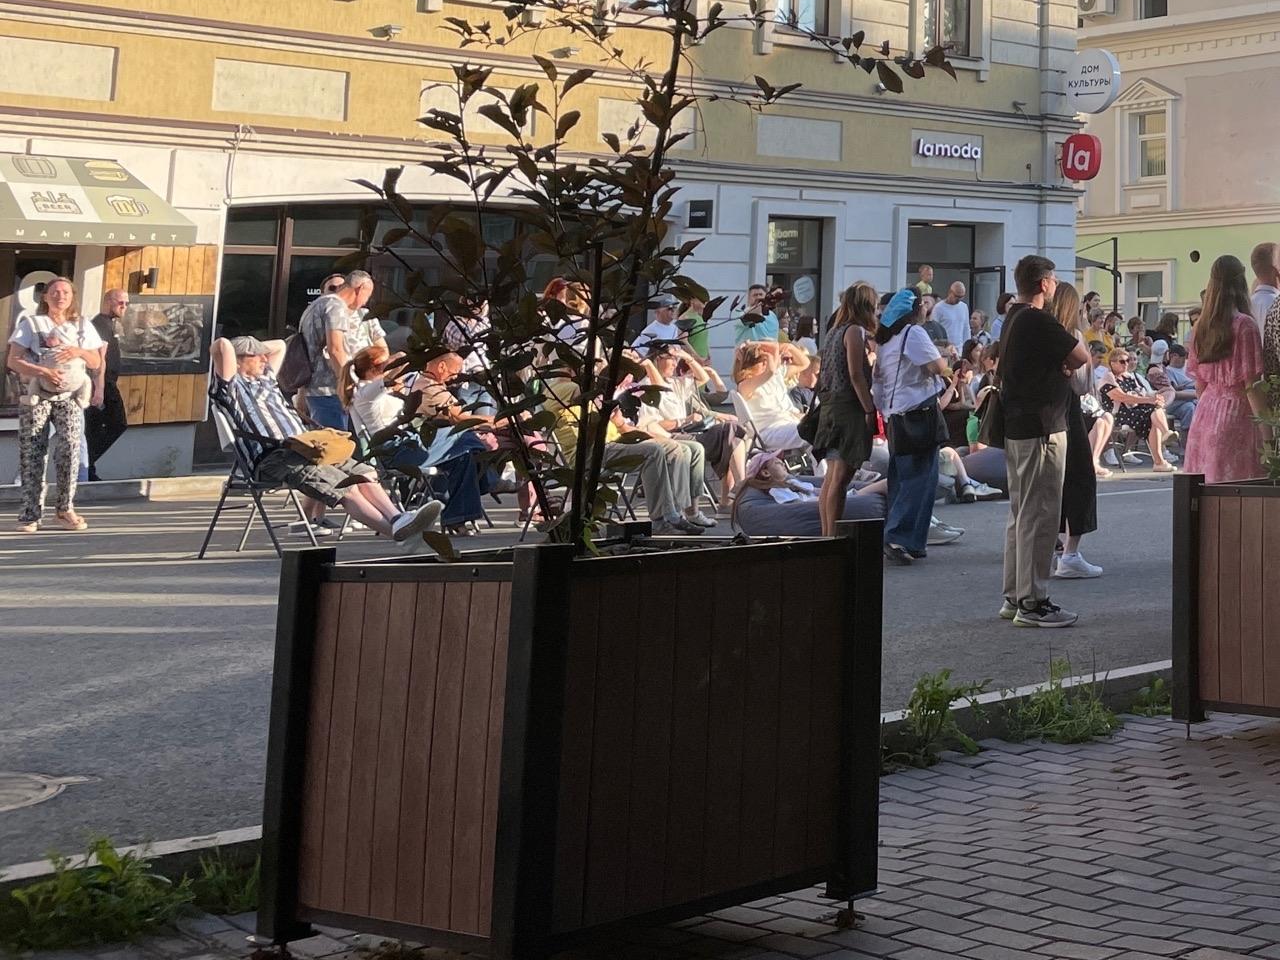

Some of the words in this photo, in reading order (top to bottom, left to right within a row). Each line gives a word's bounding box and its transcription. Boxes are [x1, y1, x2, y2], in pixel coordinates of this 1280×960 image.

[1081, 65, 1100, 75] ДОМ
[1068, 78, 1110, 88] КУЛЬТУРЫ
[918, 138, 981, 159] lamoda
[1066, 143, 1090, 171] la
